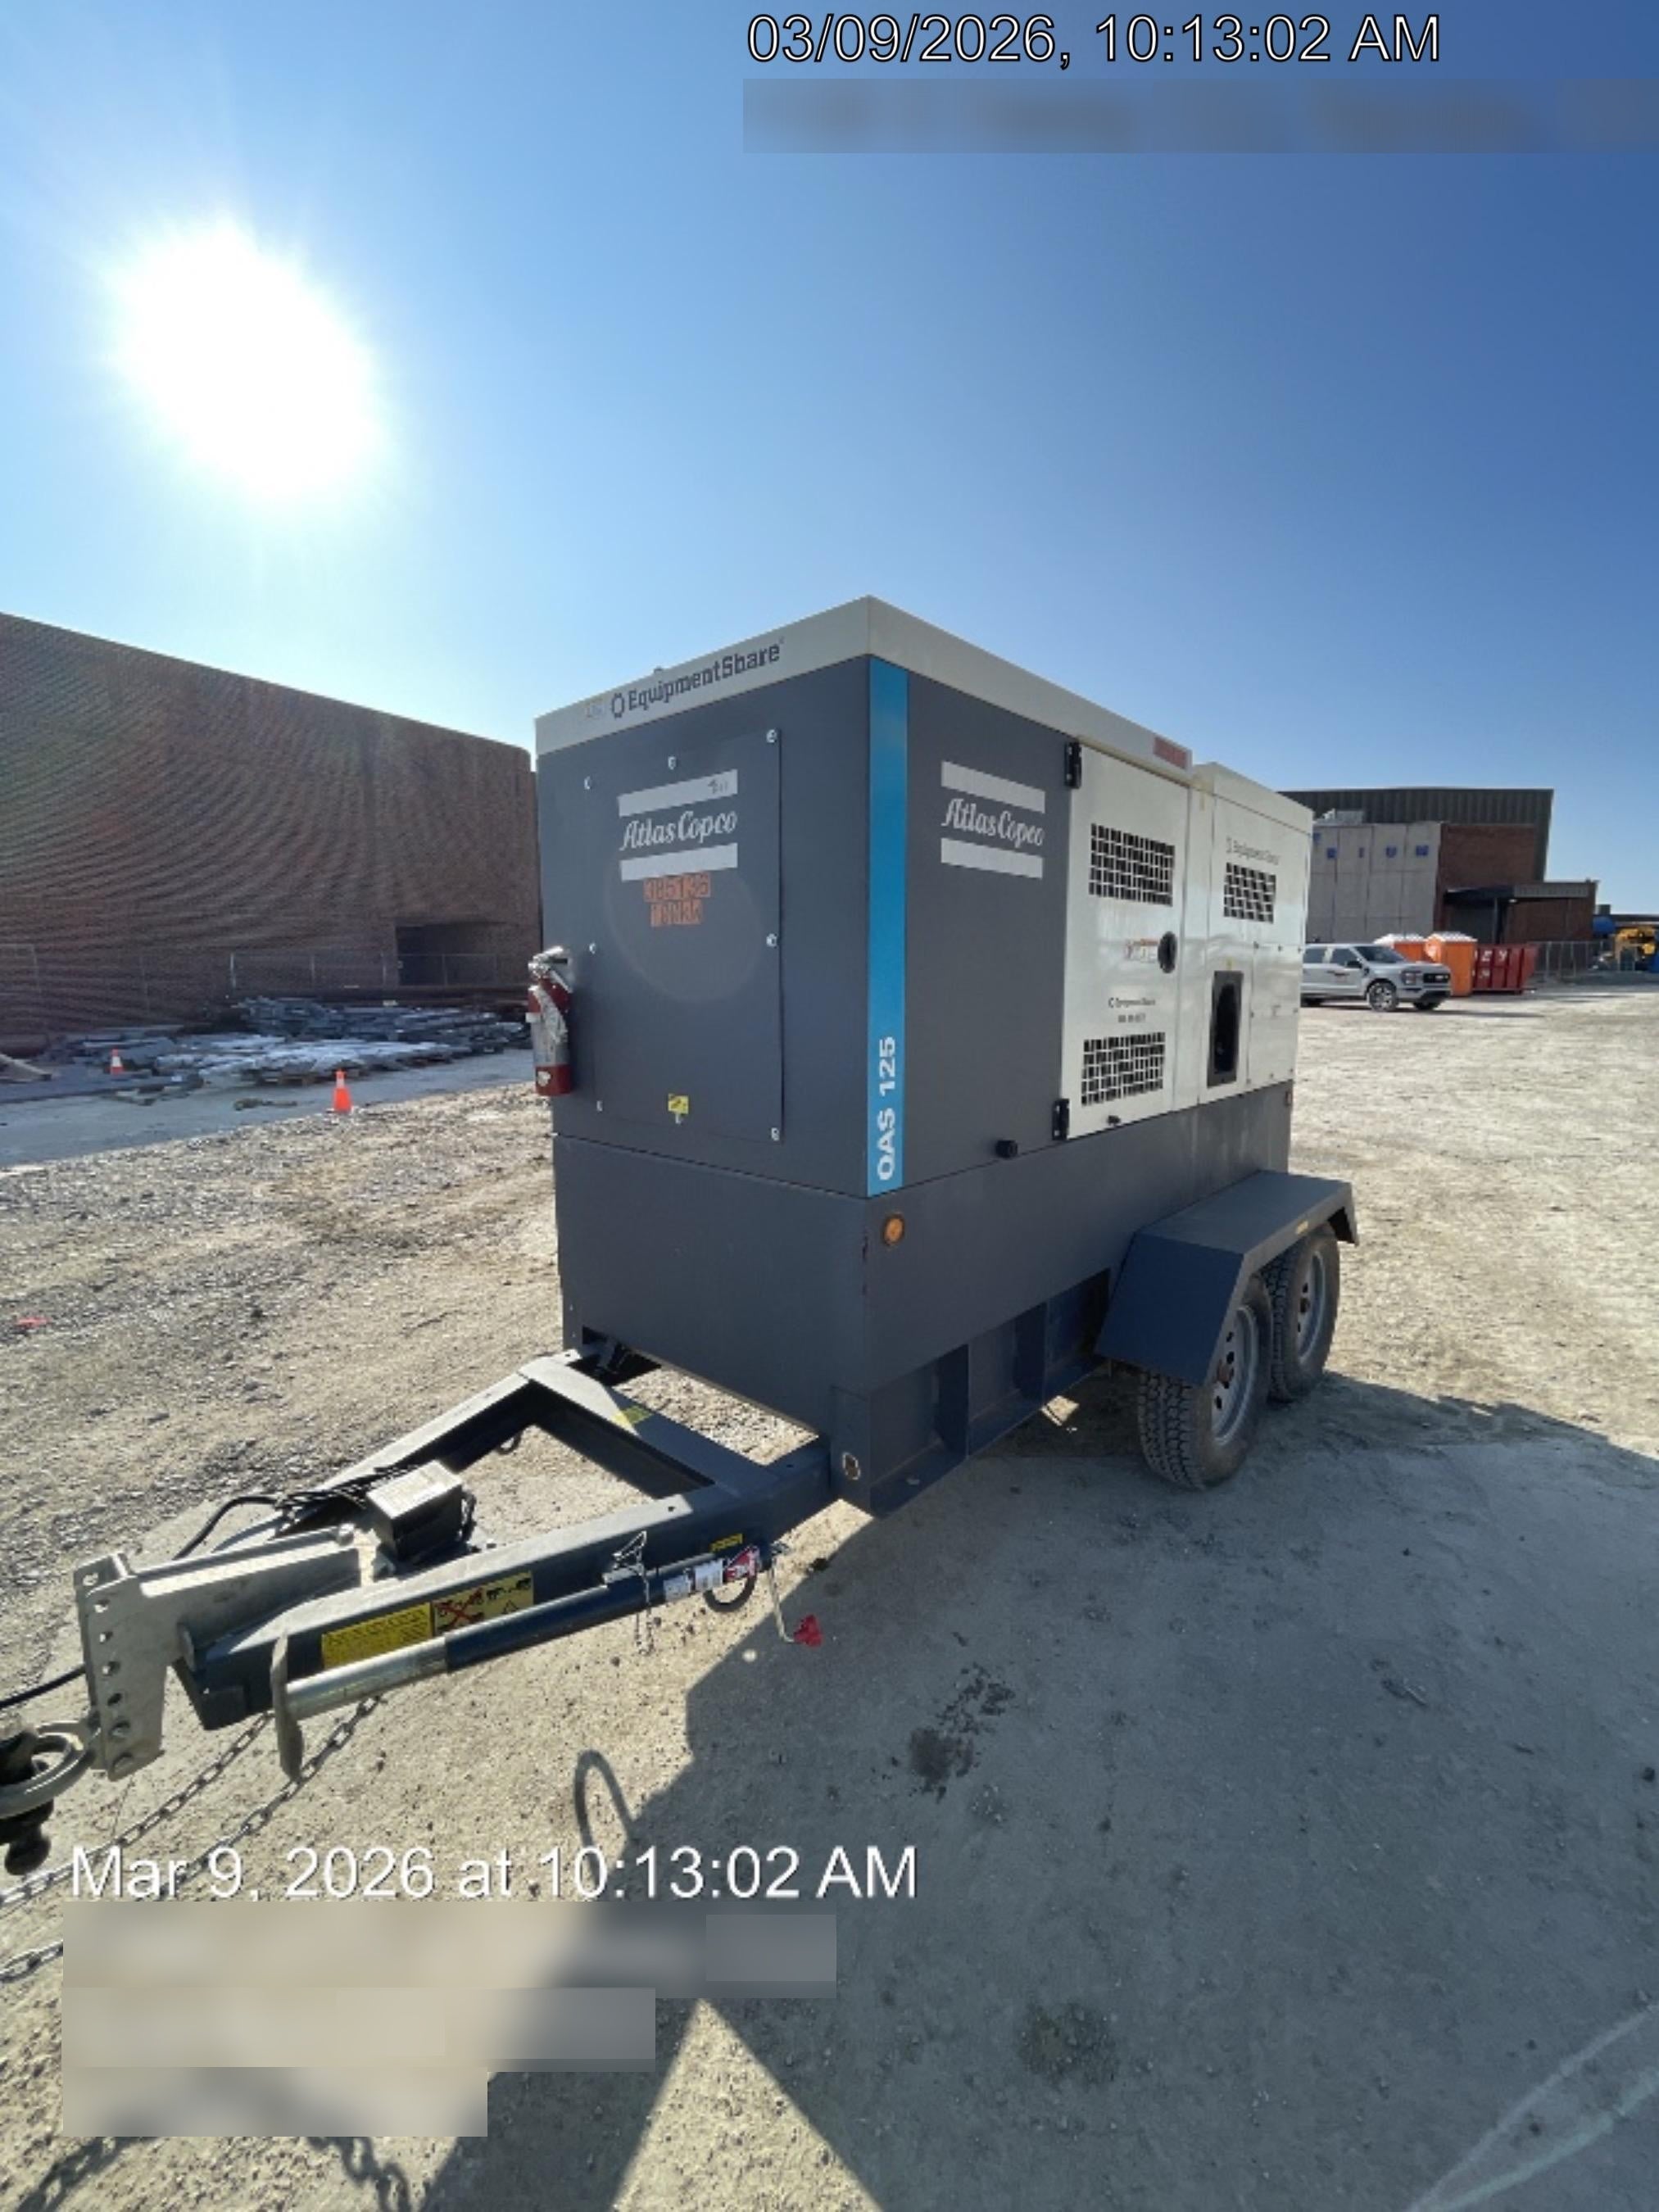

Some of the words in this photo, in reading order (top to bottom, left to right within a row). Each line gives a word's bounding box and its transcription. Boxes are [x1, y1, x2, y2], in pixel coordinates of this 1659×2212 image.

[628, 643, 781, 711] EquipmentShare
[619, 819, 676, 851] Atlas
[678, 810, 737, 844] Copco
[941, 798, 996, 836] Atlas
[997, 810, 1045, 849] Copco
[878, 1036, 895, 1096] 125
